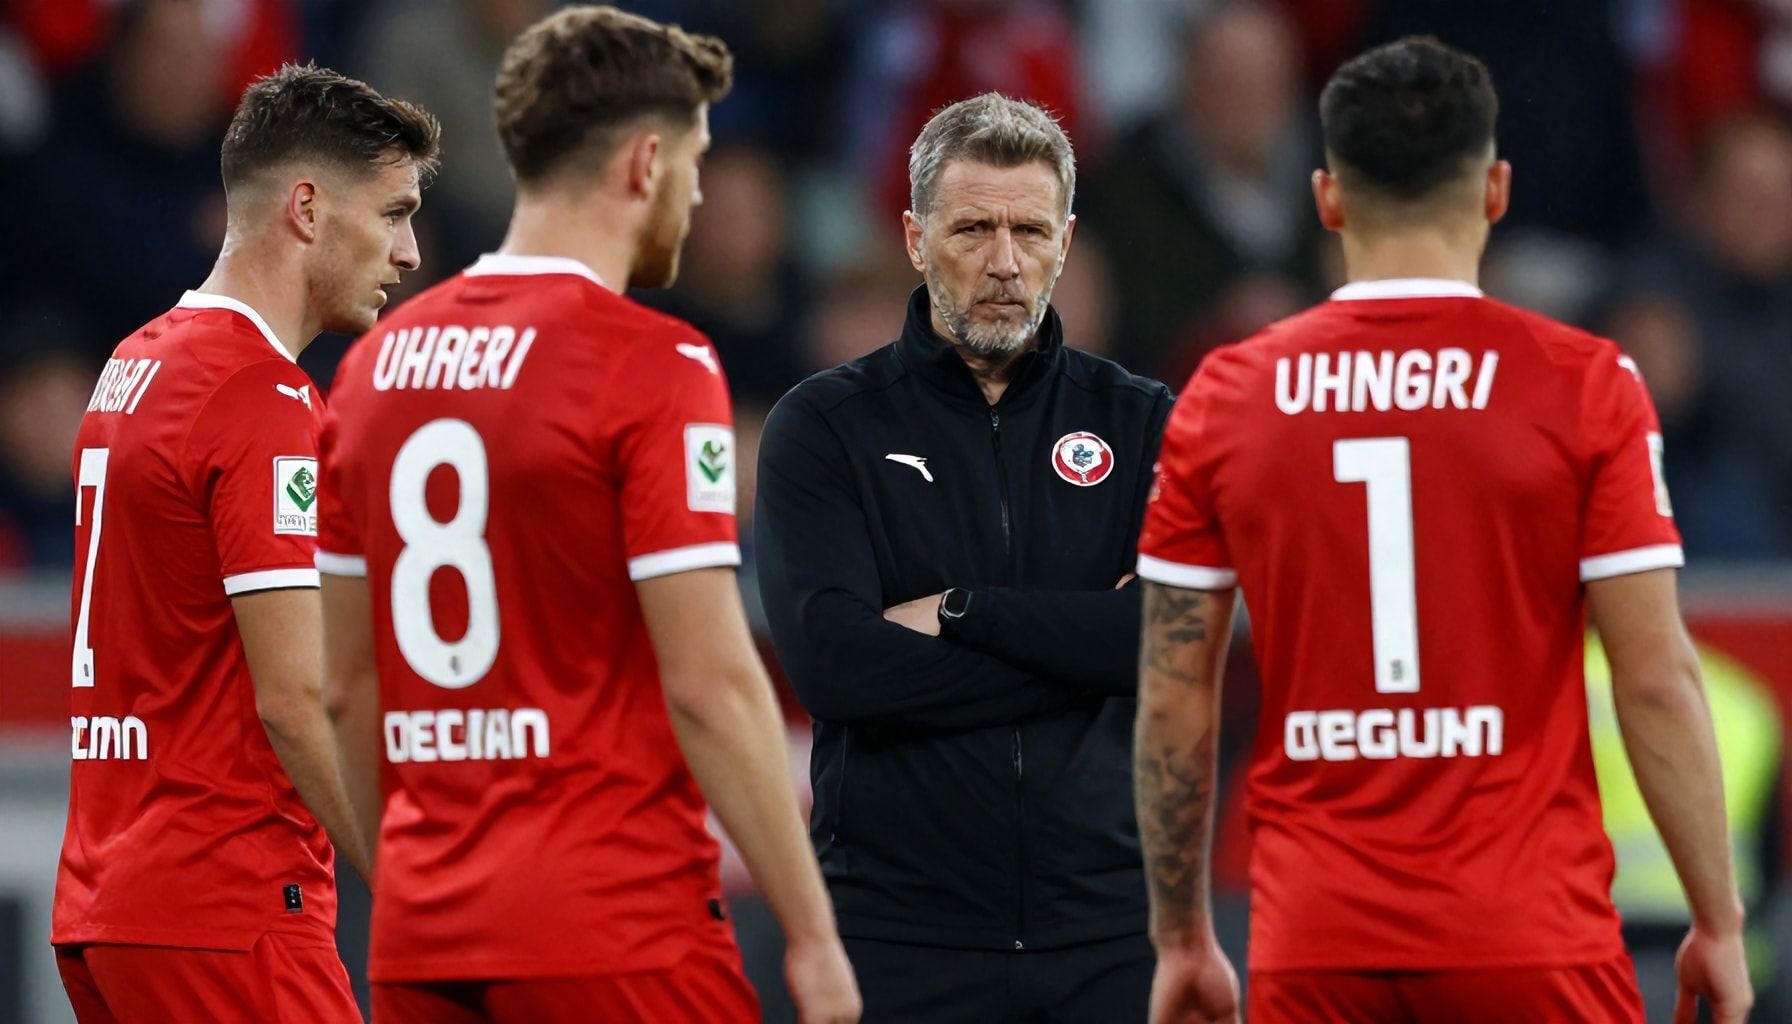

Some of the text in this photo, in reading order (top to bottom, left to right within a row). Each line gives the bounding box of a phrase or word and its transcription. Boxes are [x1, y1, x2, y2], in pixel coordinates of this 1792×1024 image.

[72, 447, 110, 688] 7
[389, 418, 500, 689] 8
[1333, 437, 1420, 694] 1
